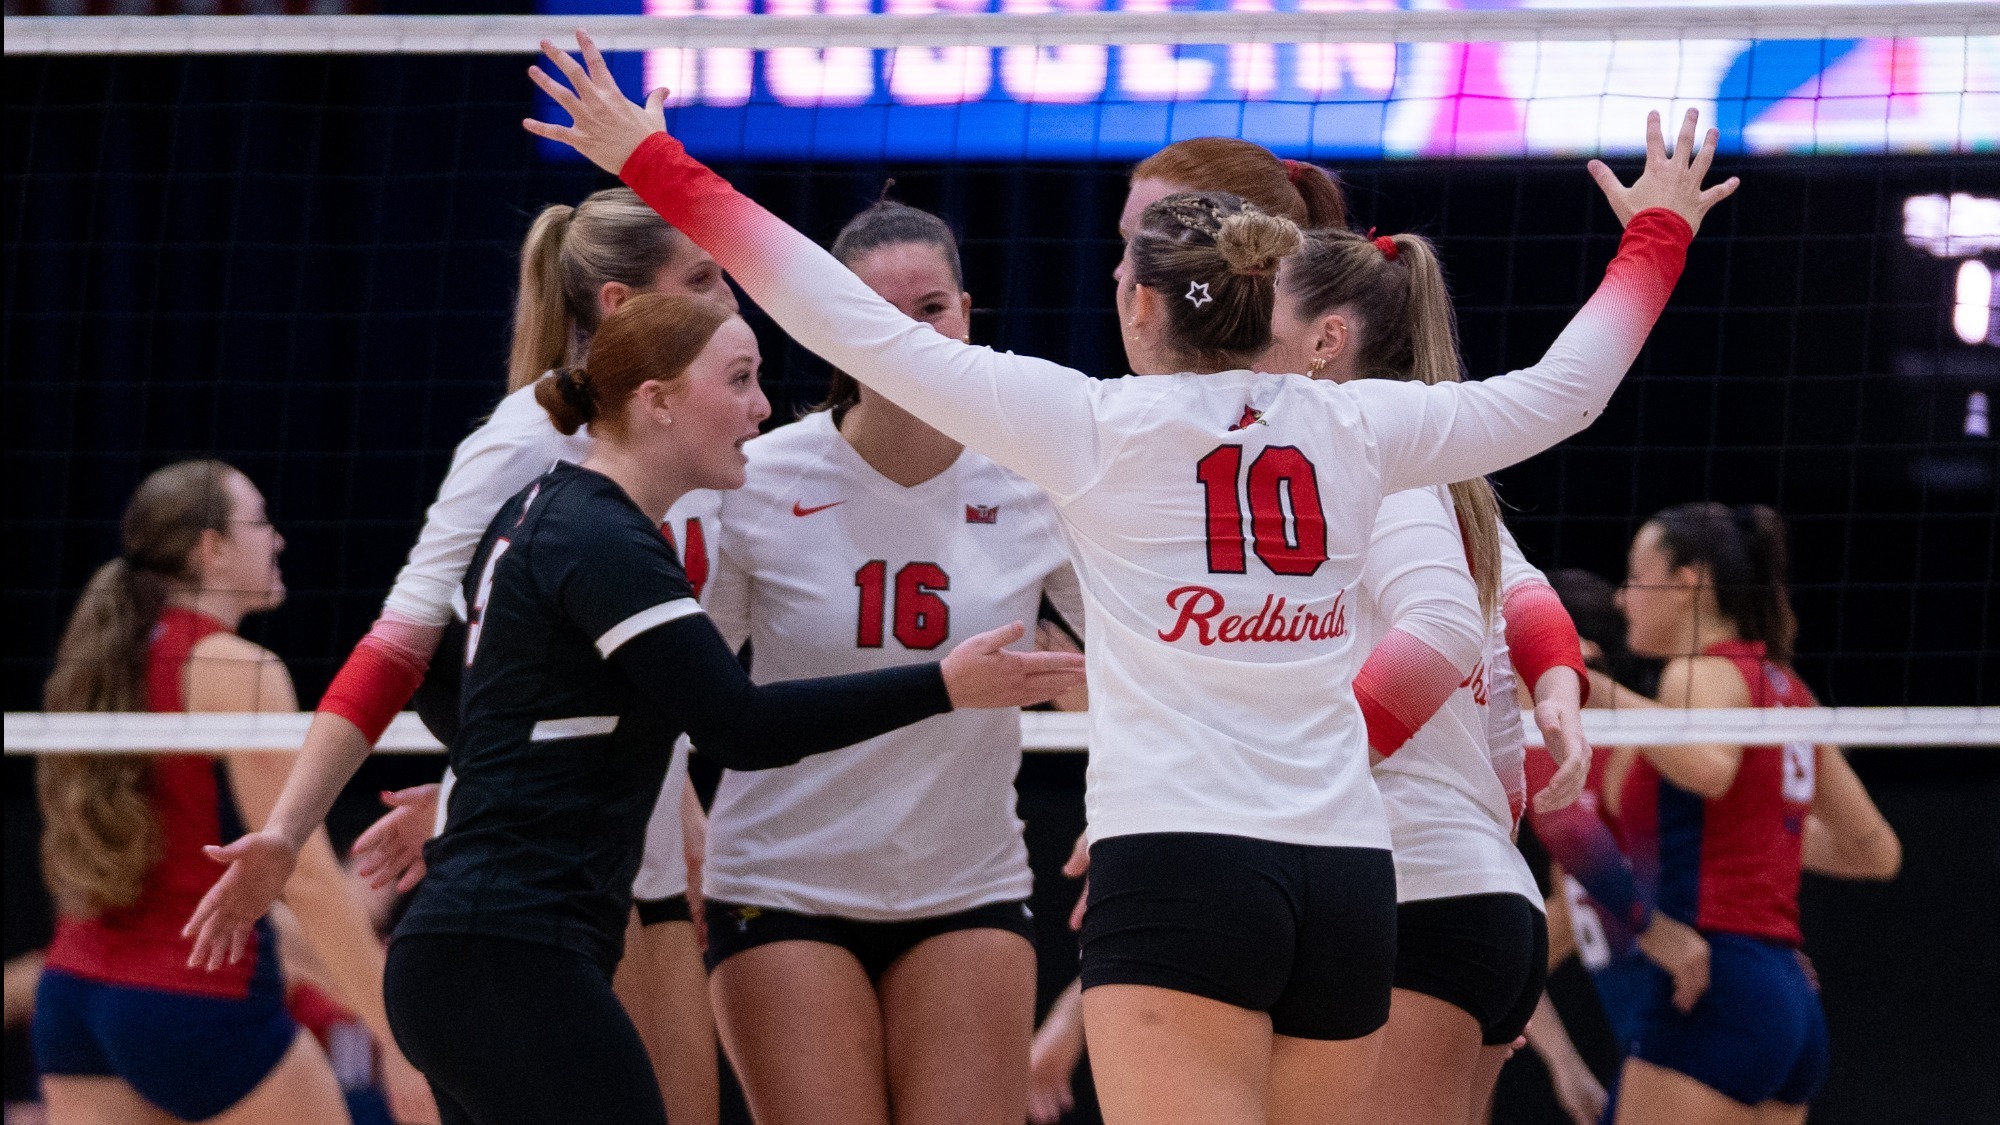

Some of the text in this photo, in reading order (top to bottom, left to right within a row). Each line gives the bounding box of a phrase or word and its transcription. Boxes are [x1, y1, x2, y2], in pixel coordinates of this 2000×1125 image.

[1196, 443, 1330, 577] 10
[855, 559, 950, 650] 16
[1157, 585, 1346, 647] Redbirds
